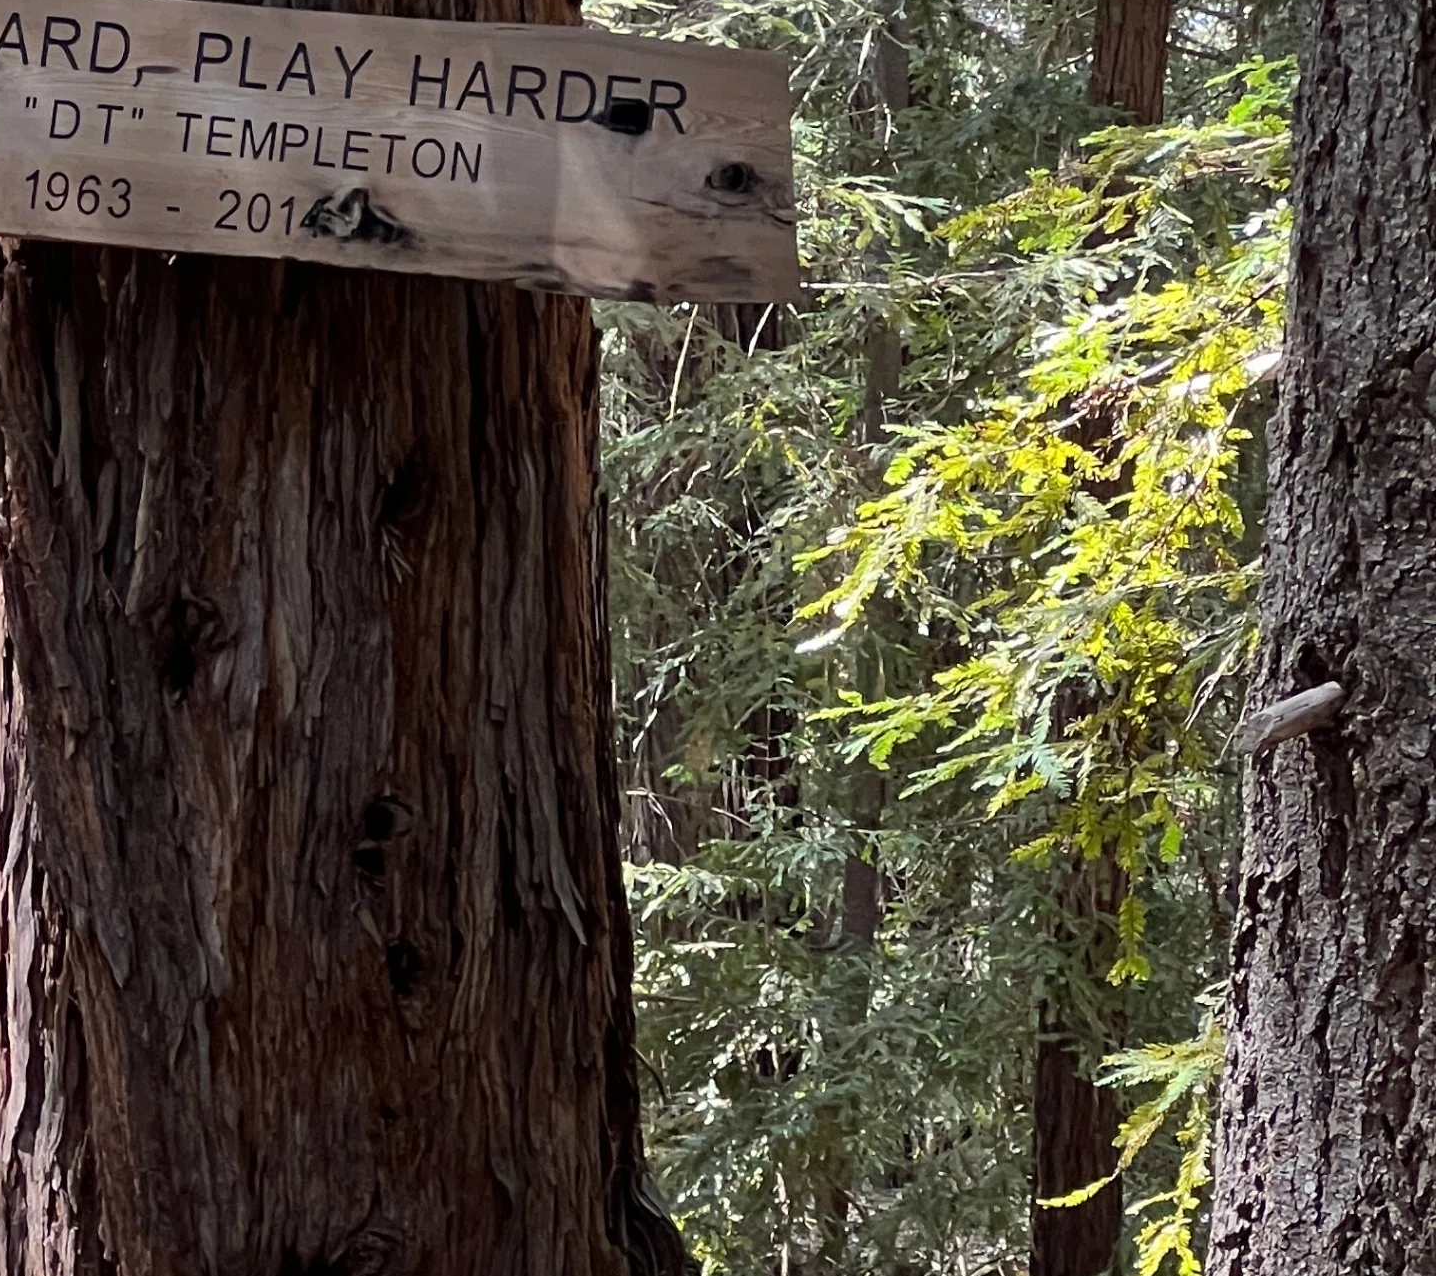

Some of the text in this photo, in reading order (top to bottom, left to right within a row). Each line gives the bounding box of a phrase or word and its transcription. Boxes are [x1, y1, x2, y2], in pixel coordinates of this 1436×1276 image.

[193, 31, 374, 100] PLAY
[408, 53, 687, 135] HARDER
[24, 95, 144, 145] "DT"
[175, 112, 483, 183] TEMPLETON
[24, 169, 132, 219] 1963
[166, 205, 181, 213] -
